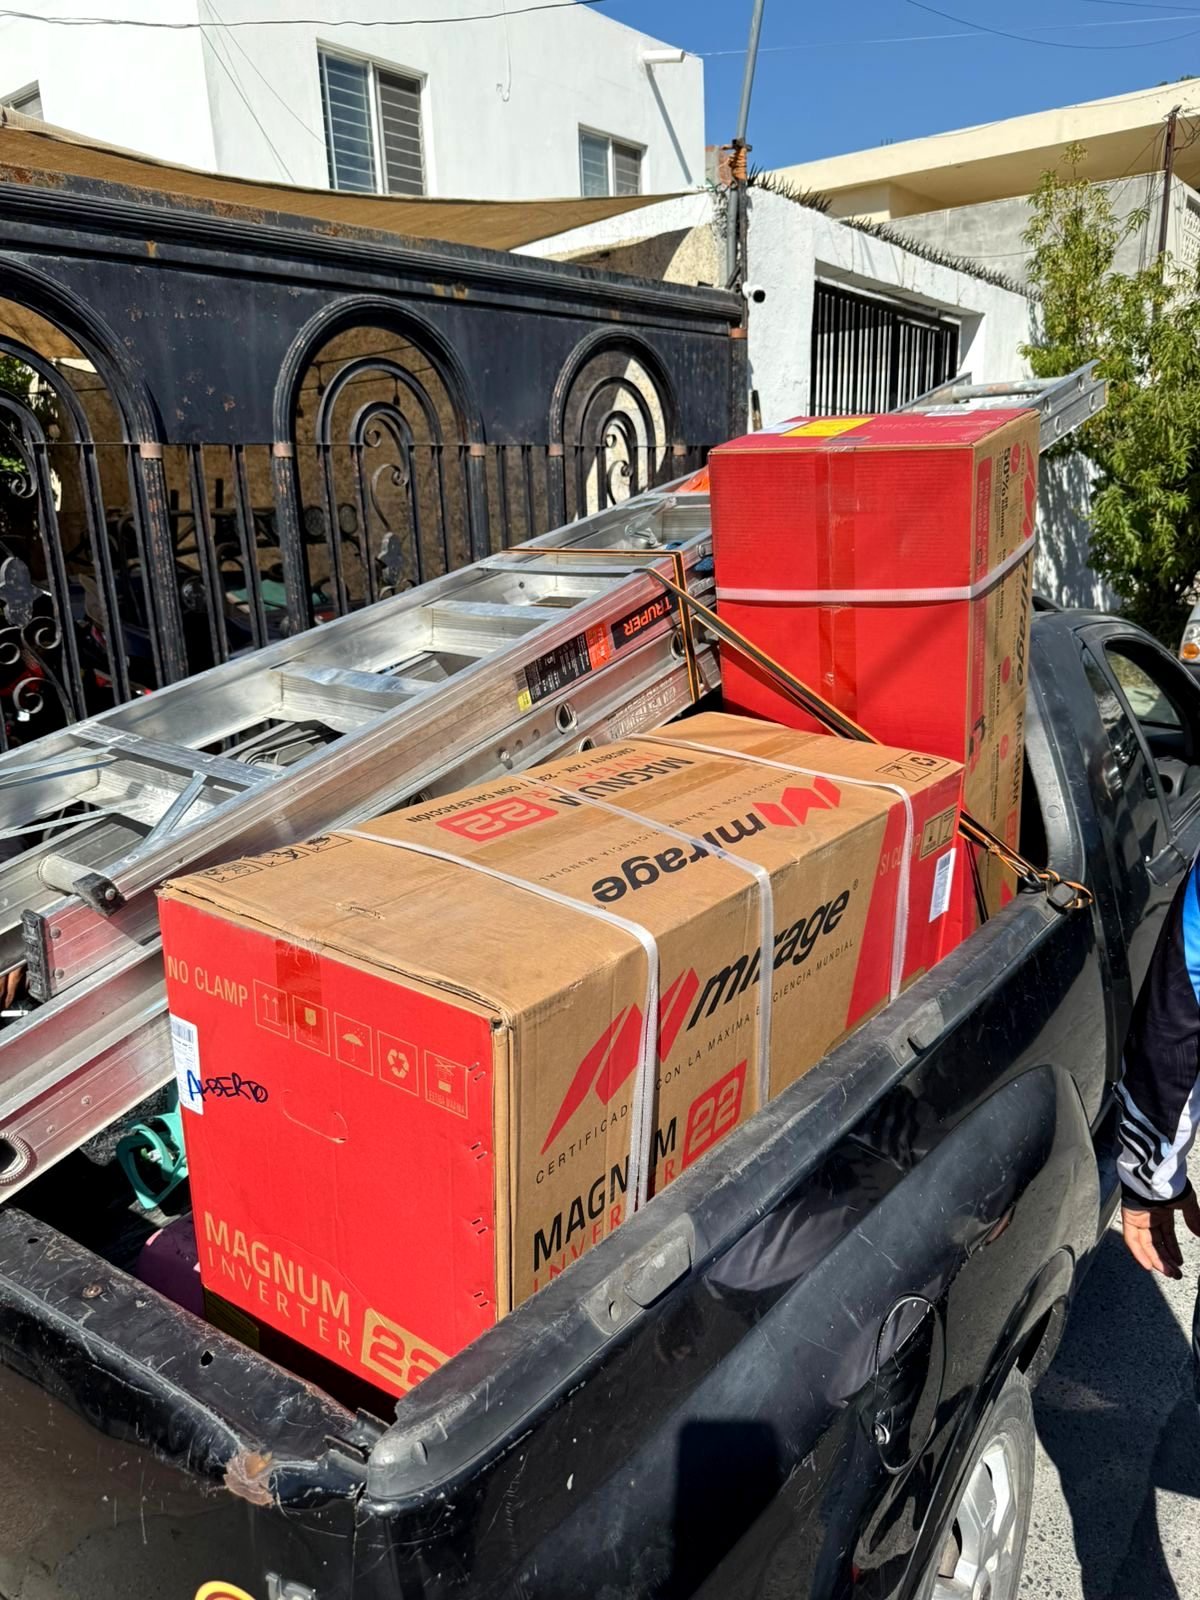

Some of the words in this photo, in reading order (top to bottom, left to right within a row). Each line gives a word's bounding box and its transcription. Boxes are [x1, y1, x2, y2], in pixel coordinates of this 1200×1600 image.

[1002, 447, 1011, 497] 50%
[623, 596, 673, 637] TRUPER
[496, 784, 522, 798] CON
[522, 752, 664, 802] INVERTR
[548, 757, 695, 807] MAGNUM
[406, 793, 495, 823] CALEFACCIÓN
[450, 801, 541, 835] 22
[538, 856, 598, 882] MUNDIAL
[591, 813, 767, 903] mirage
[167, 955, 188, 984] NO
[194, 966, 249, 1008] CLAMP
[186, 1069, 269, 1103] ALBERTO
[535, 1103, 633, 1185] CERTIFICAD
[656, 1065, 681, 1090] CON
[688, 1050, 702, 1067] LA
[708, 1013, 750, 1052] MAXIMA
[756, 968, 812, 1016] ECIENCIA
[815, 939, 854, 972] MUNDIAL
[690, 1077, 738, 1150] 22
[533, 1116, 677, 1273] MAGNM
[533, 1158, 676, 1294] INVERR
[204, 1211, 349, 1327] MAGNUM
[208, 1246, 353, 1357] INVERTER
[368, 1323, 442, 1384] 22
